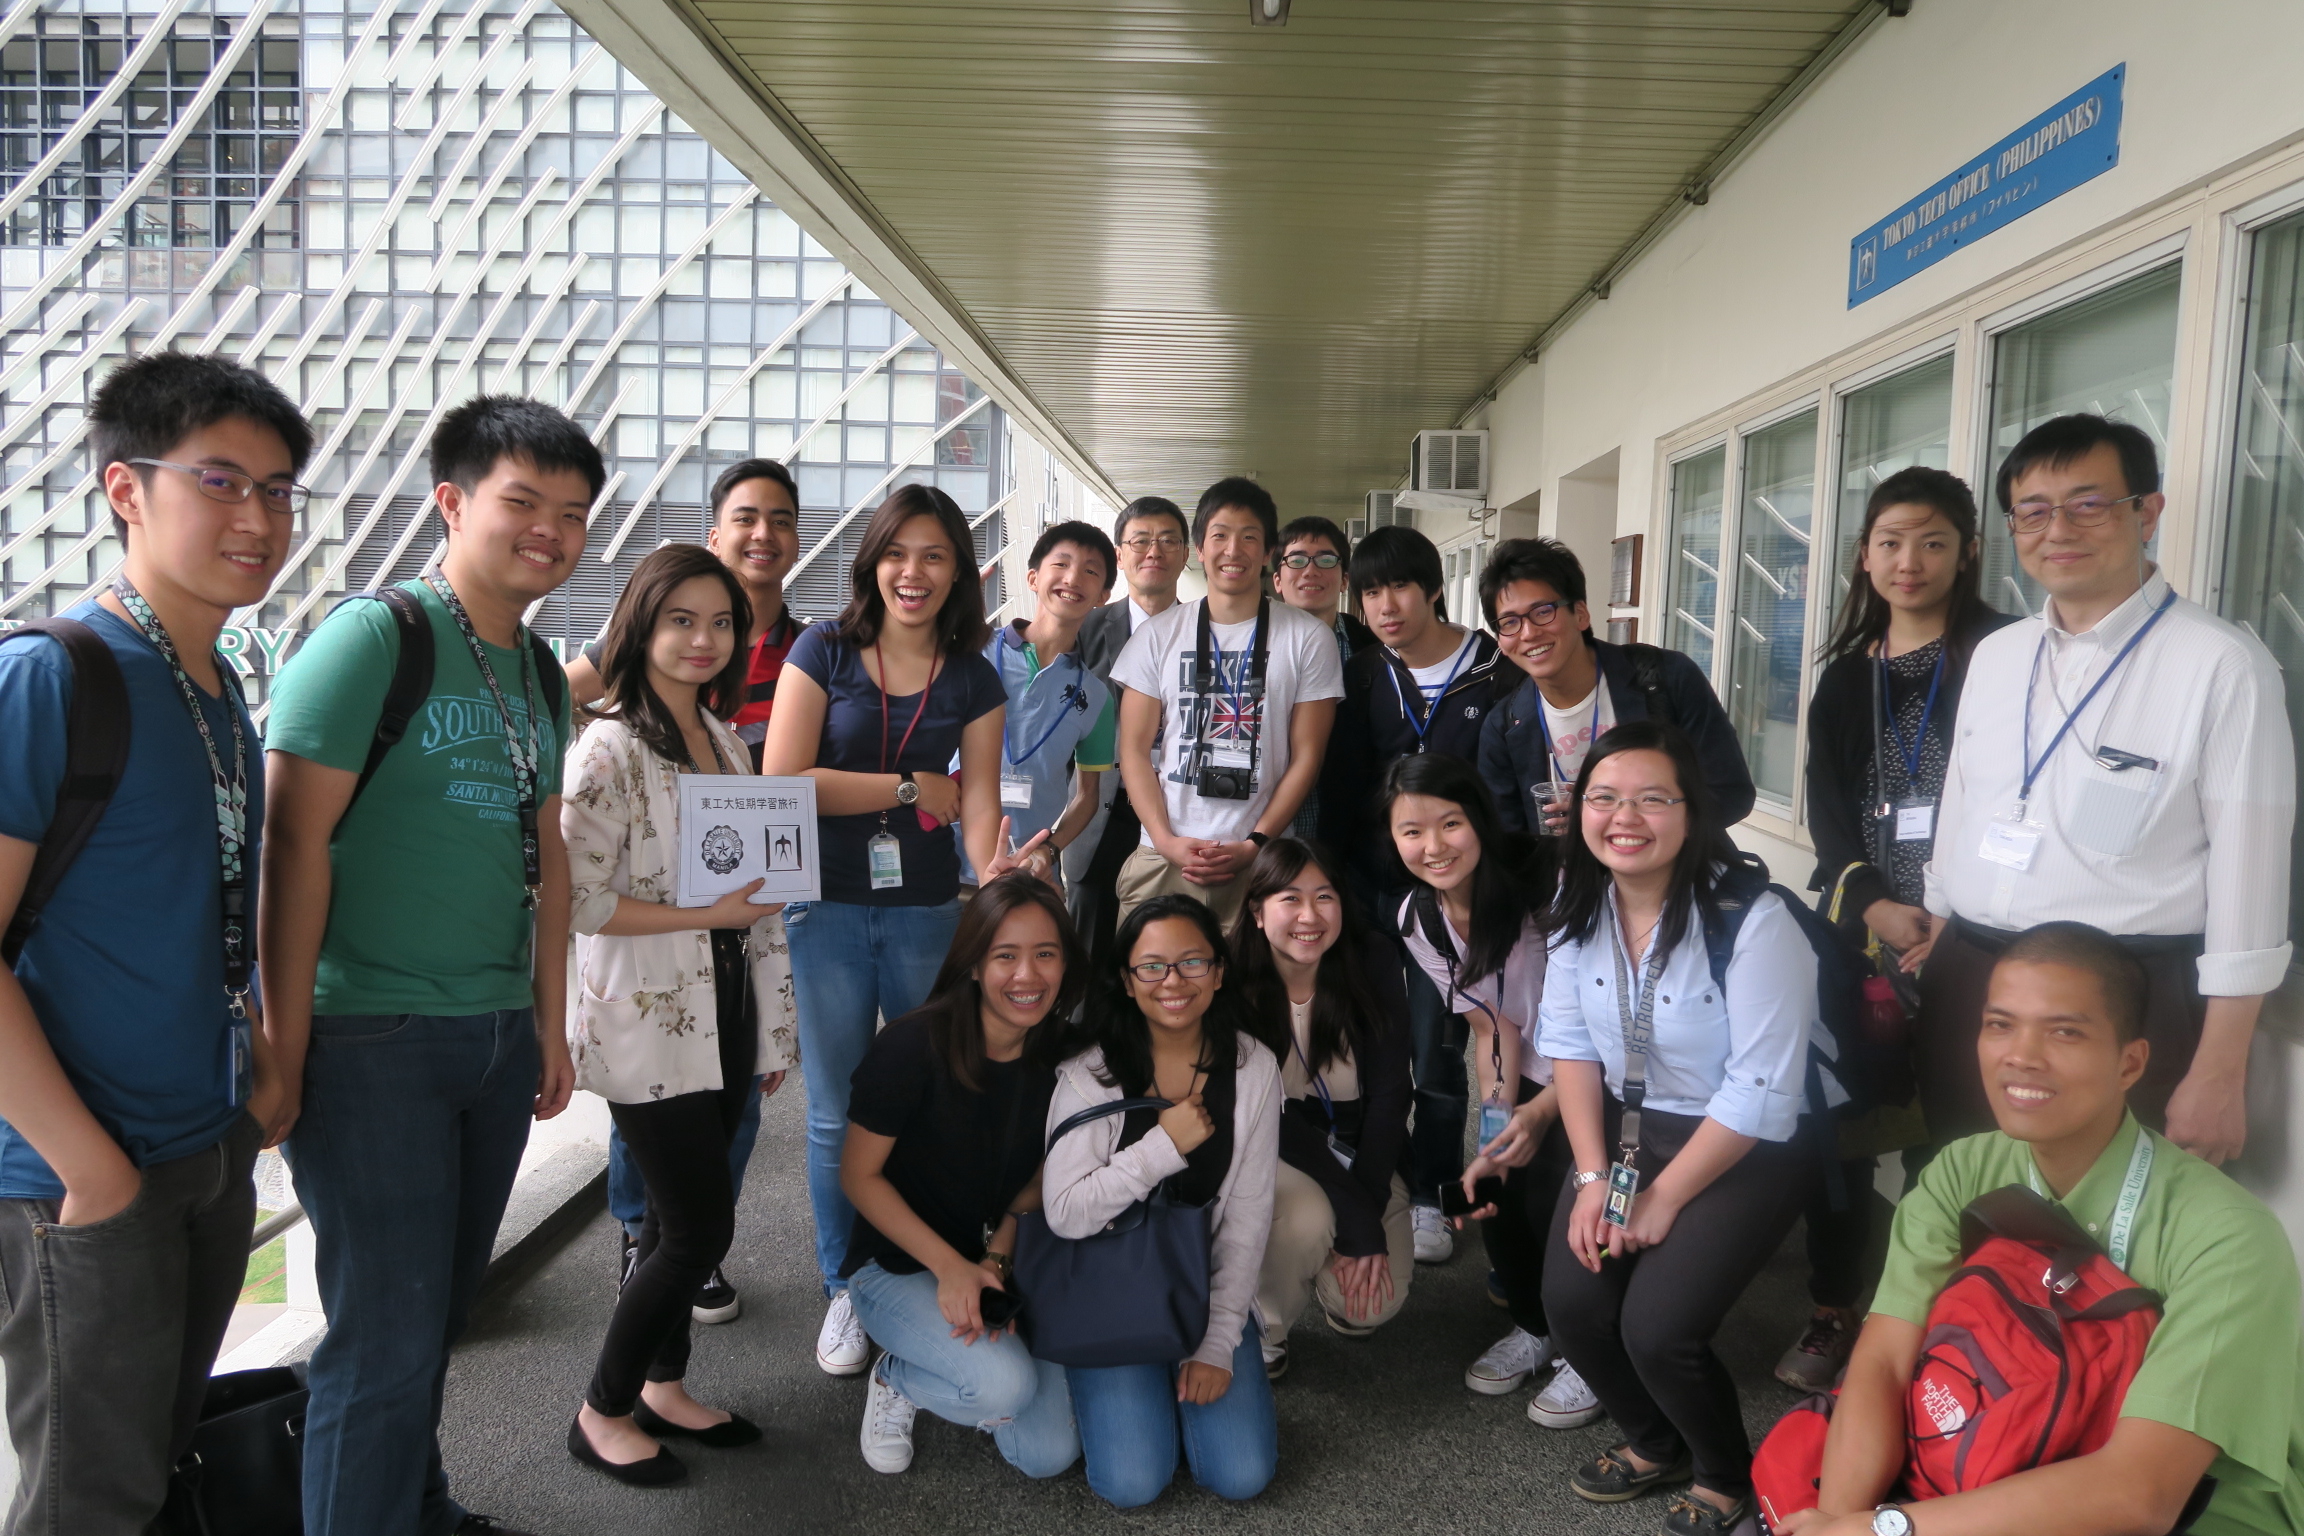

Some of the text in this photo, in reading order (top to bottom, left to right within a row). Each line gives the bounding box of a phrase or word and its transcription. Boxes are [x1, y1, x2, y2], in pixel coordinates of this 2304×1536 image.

[1883, 94, 2100, 251] TOKYO TECH OFFICE (PHILIPPINES)
[422, 700, 506, 749] SOUTH
[446, 783, 488, 801] SANTA
[700, 797, 799, 811] 東工大短期学習旅行
[1631, 959, 1662, 1055] RETROSPEC
[2112, 1145, 2151, 1247] De La Salle University
[1920, 1393, 1944, 1423] FACE
[1922, 1377, 1952, 1418] NORTH
[1939, 1383, 1960, 1410] THE
